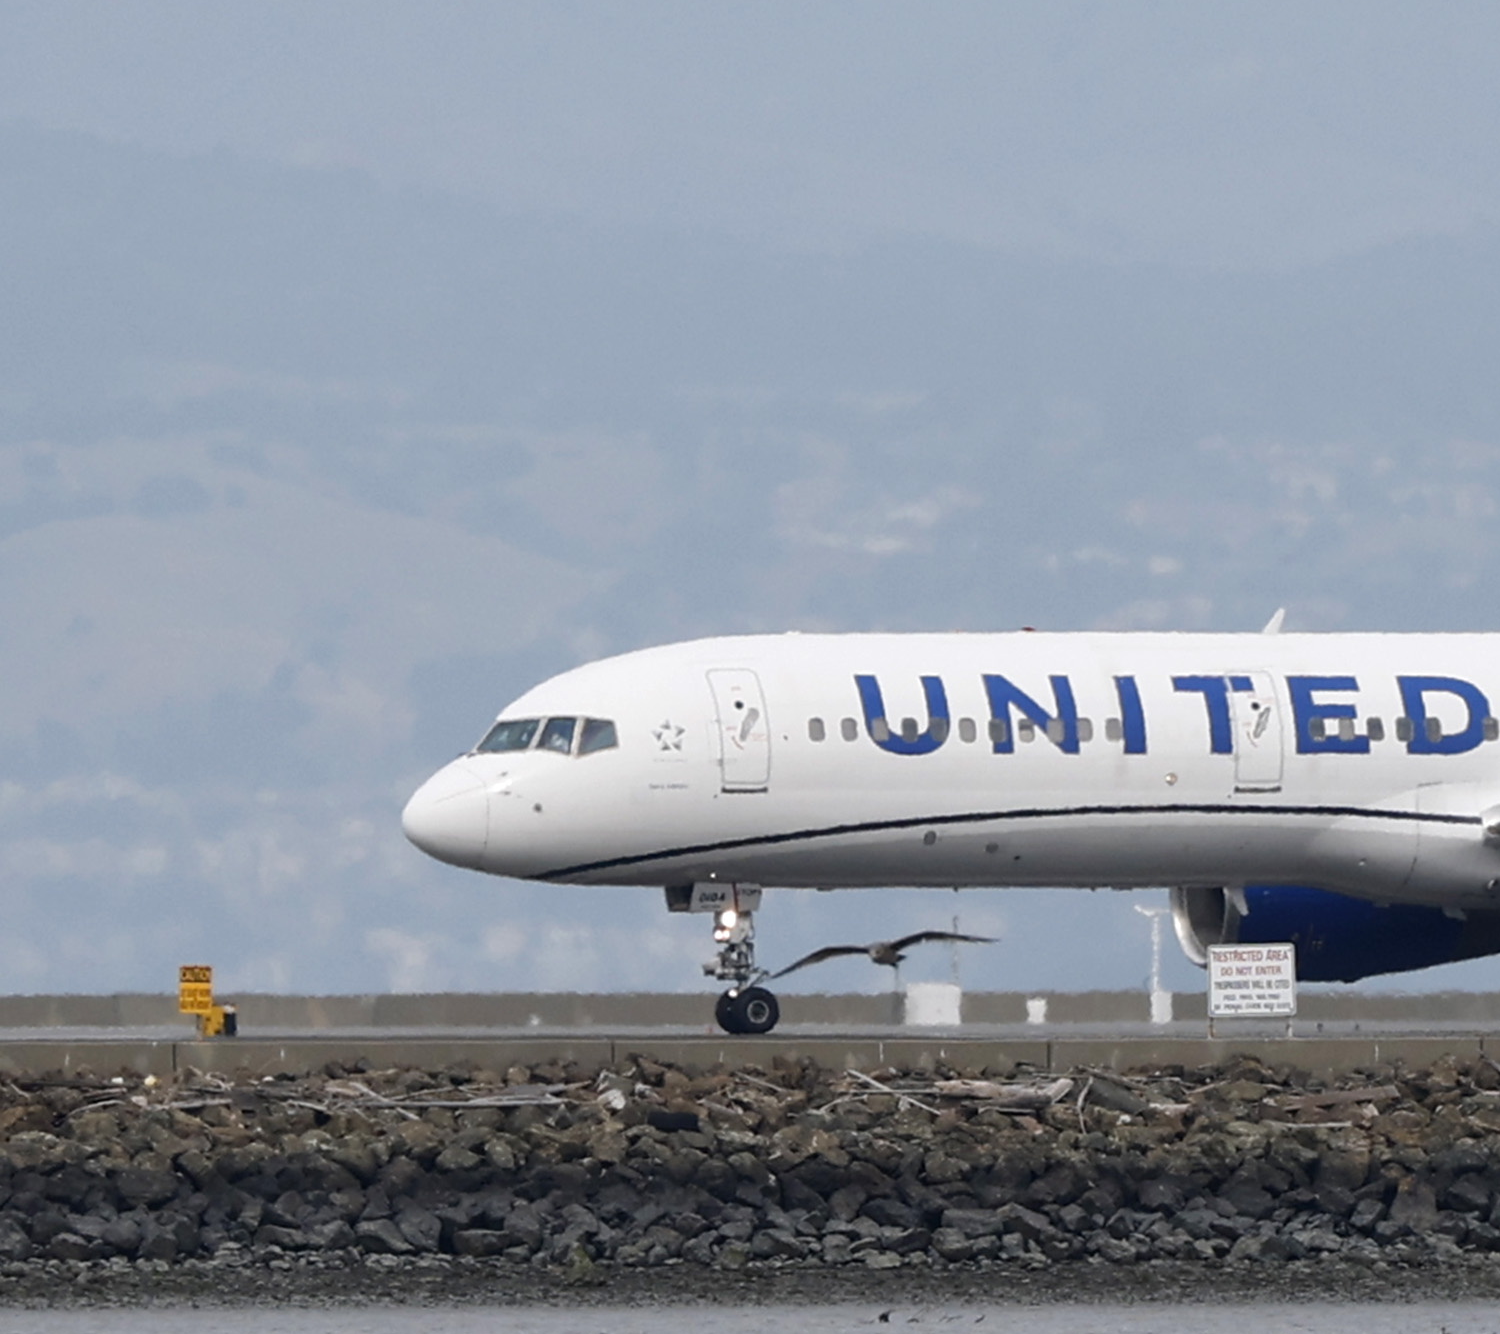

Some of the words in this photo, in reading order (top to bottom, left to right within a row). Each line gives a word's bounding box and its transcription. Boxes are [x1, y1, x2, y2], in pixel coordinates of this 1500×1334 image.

[854, 675, 1493, 756] UNITED
[1212, 950, 1263, 962] RESTRICTED
[1265, 949, 1289, 961] AREA
[1220, 967, 1234, 977] DO
[1235, 967, 1253, 977] NOT
[1255, 965, 1282, 976] ENTER
